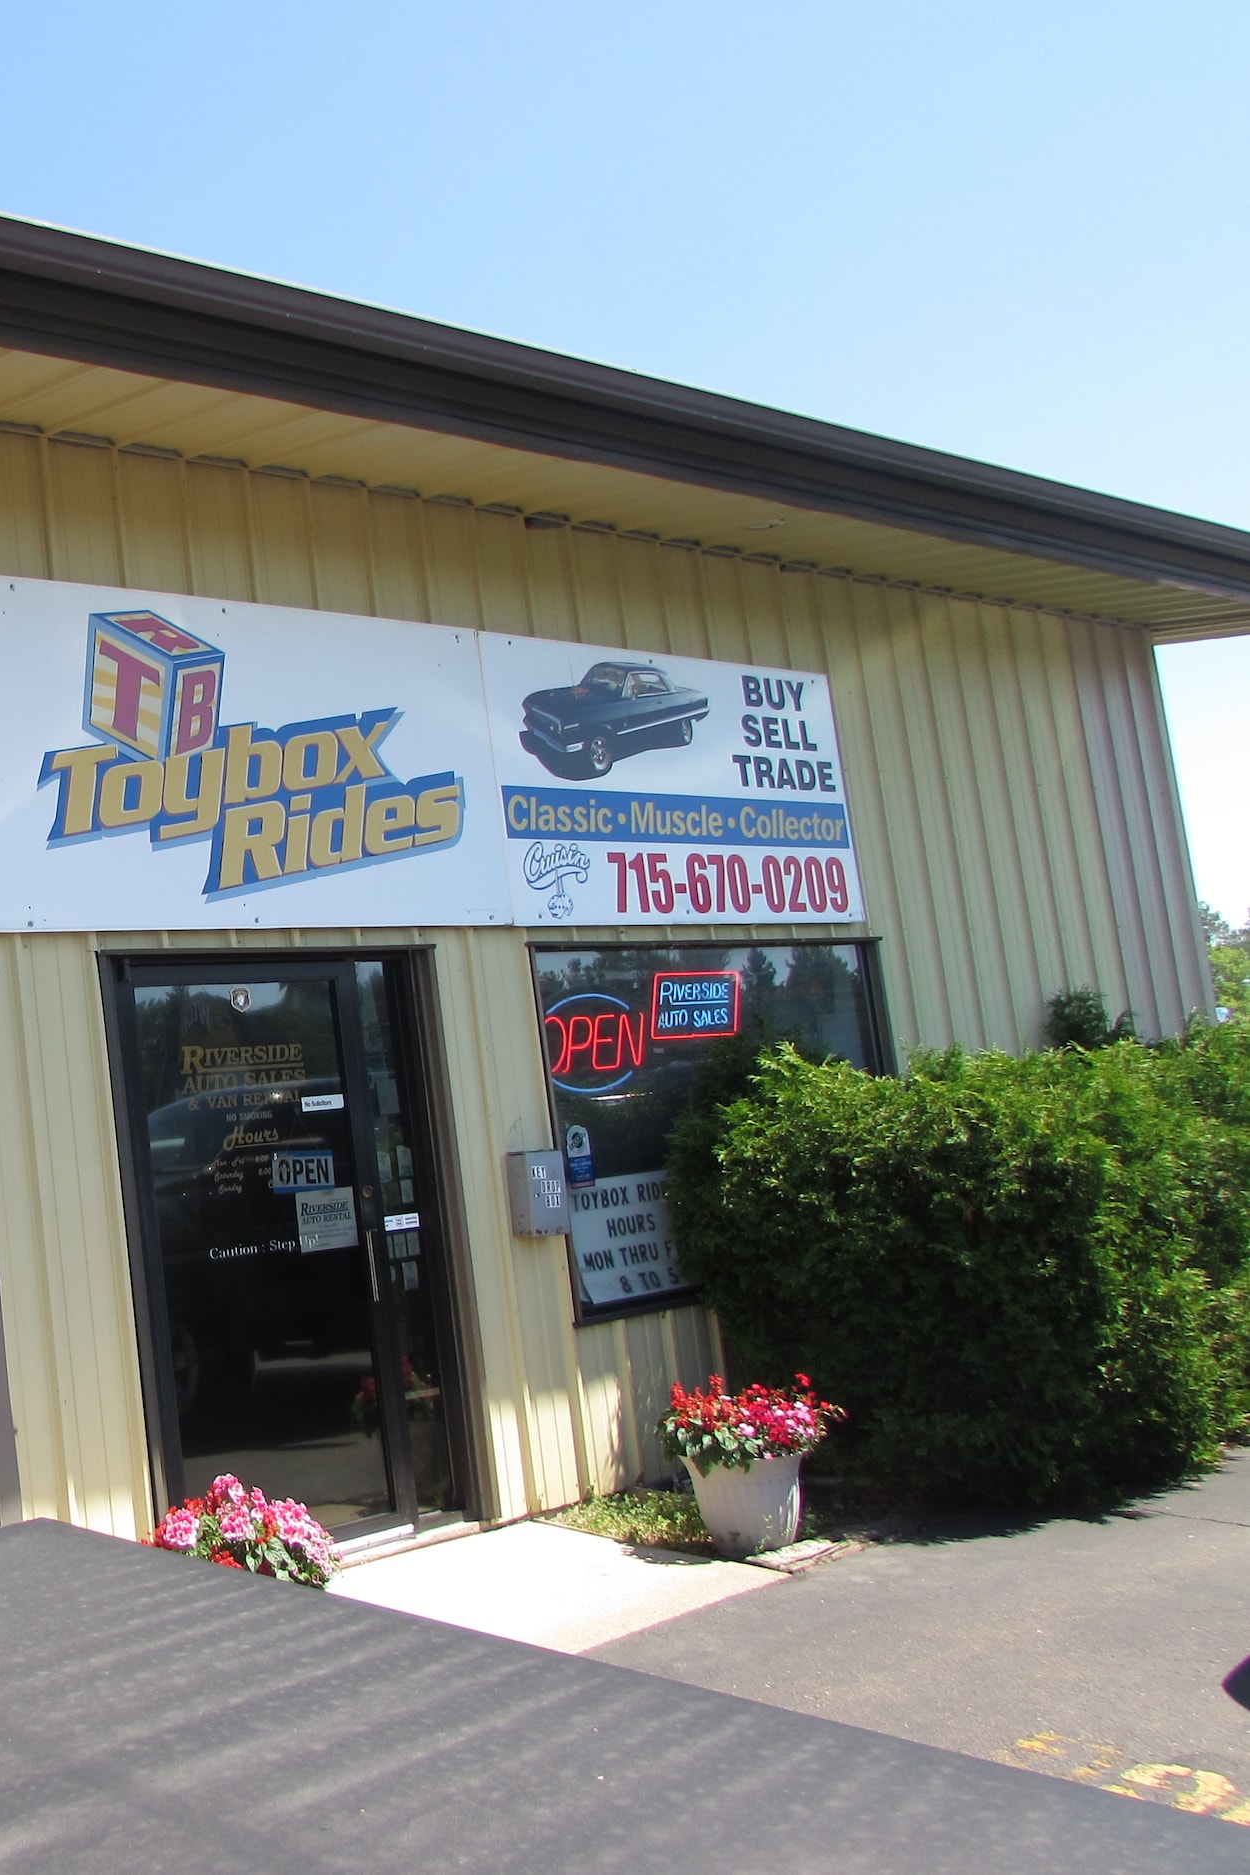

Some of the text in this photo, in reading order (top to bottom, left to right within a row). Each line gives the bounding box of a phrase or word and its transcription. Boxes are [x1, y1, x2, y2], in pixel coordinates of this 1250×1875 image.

[741, 674, 805, 713] BUY
[741, 714, 819, 752] SELL
[45, 712, 398, 845] Toybox
[732, 754, 837, 792] TRADE
[507, 794, 845, 843] Classic Muscle Collector
[210, 777, 462, 895] Rides
[606, 851, 849, 914] 715-670-0209
[659, 981, 729, 1005] RIVERSIDE
[657, 1007, 728, 1029] AUTO SALES
[544, 1012, 644, 1074] OPEN
[180, 1043, 303, 1075] RIVERSIDE
[181, 1068, 306, 1095] AUTO SALES
[188, 1090, 302, 1110] & VAN RENAL
[226, 1110, 273, 1122] NO SMOKING
[223, 1125, 279, 1151] Hours
[278, 1158, 330, 1185] OPEN
[531, 1166, 546, 1179] KEY
[541, 1181, 561, 1193] DROP
[573, 1181, 665, 1212] TOYBOX RID
[545, 1195, 561, 1207] BOX
[302, 1211, 353, 1225] AUTO RENTAL
[606, 1213, 656, 1238] HOURS
[210, 1244, 258, 1260] Caution
[270, 1240, 296, 1251] Step
[300, 1234, 319, 1248] Up!
[582, 1249, 615, 1272] MON
[618, 1241, 659, 1267] THRU
[619, 1266, 678, 1293] 8 TO 5
